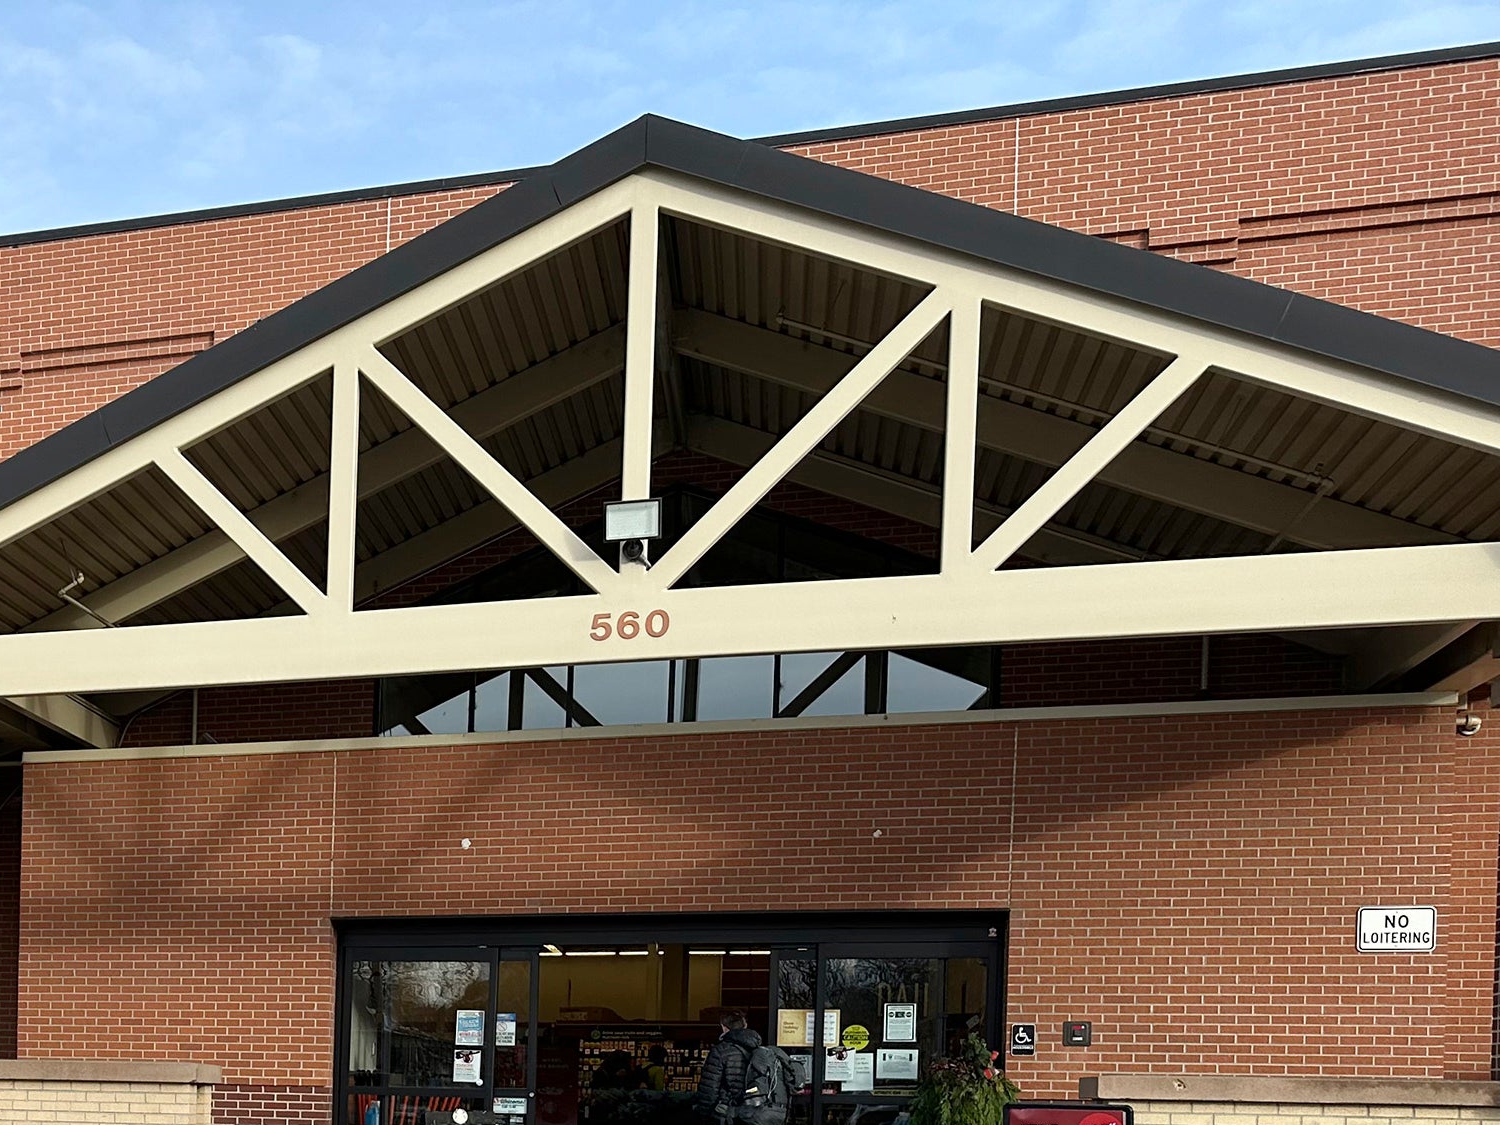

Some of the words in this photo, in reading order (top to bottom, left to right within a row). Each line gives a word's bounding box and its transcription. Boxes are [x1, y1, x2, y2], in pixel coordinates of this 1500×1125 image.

[589, 609, 670, 641] 560
[1384, 915, 1409, 928] NO
[1363, 932, 1430, 943] LOITERING
